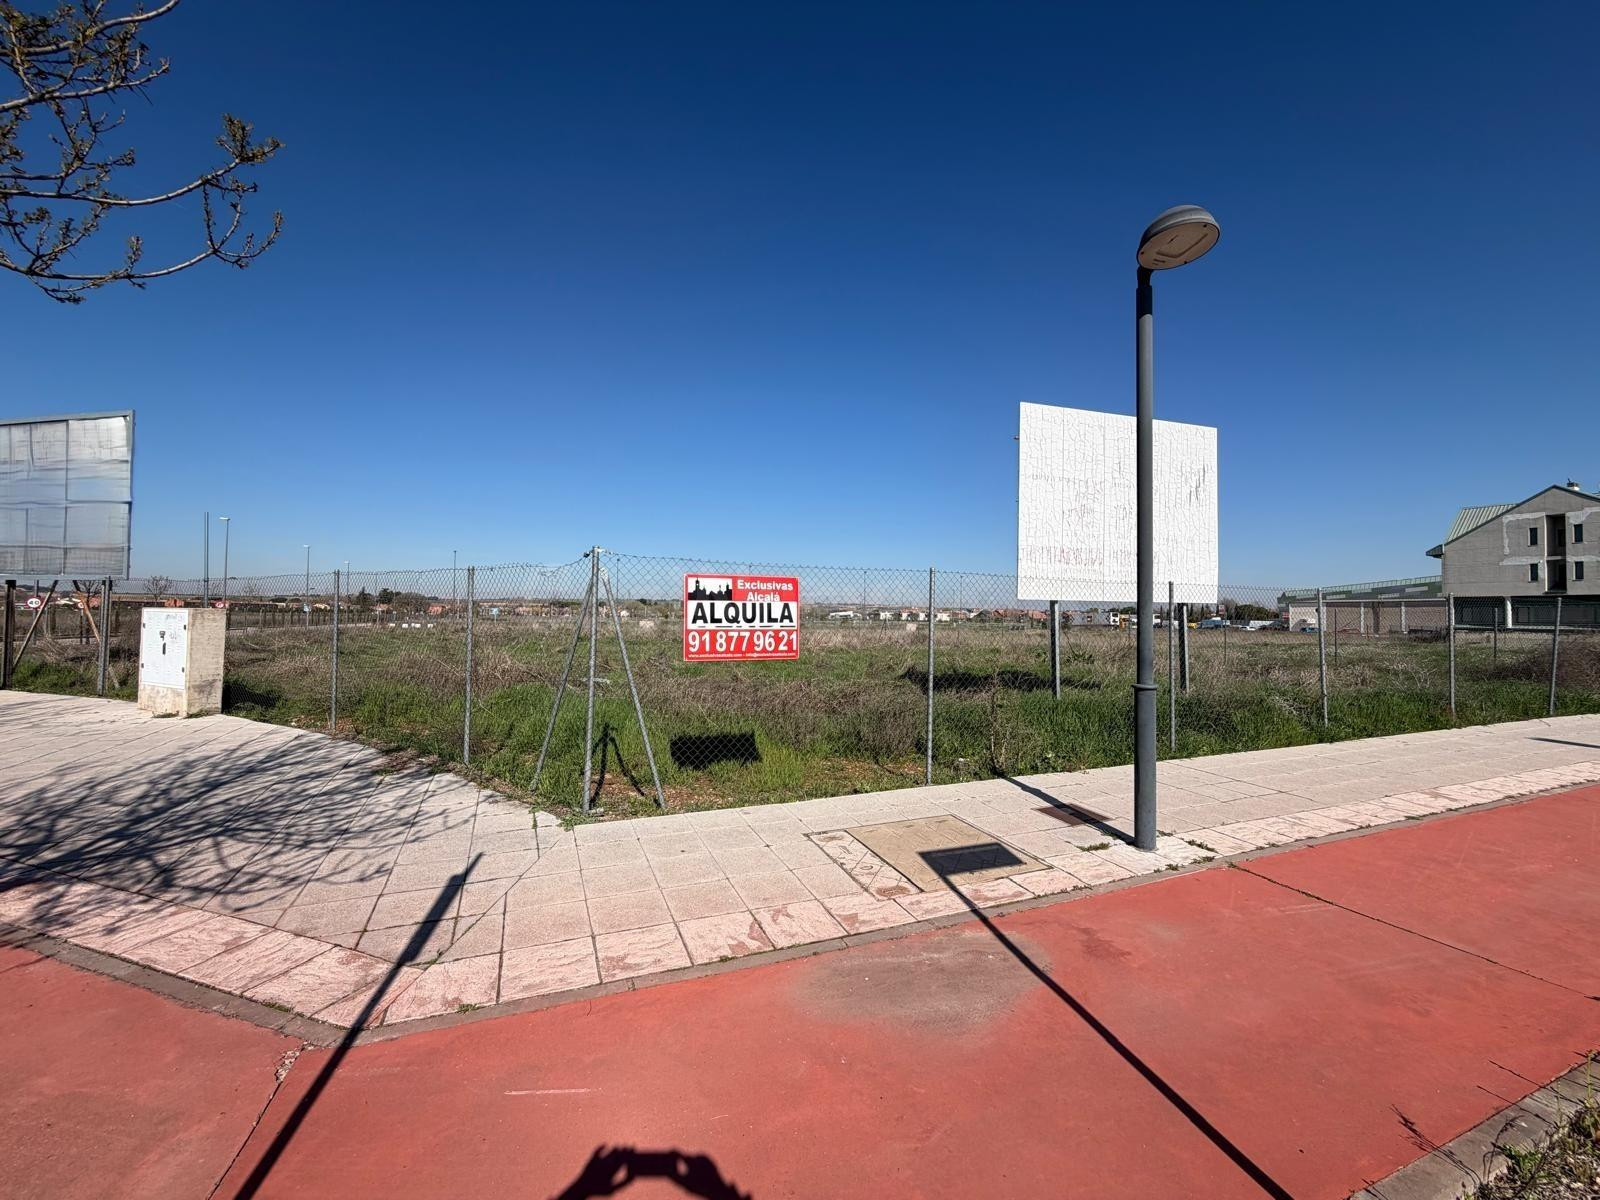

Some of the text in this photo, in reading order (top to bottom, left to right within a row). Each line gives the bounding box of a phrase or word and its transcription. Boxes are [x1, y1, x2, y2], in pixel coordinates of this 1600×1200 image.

[737, 580, 793, 590] Exclusivas
[746, 591, 780, 602] Alcalá
[691, 602, 794, 624] ALQUILA
